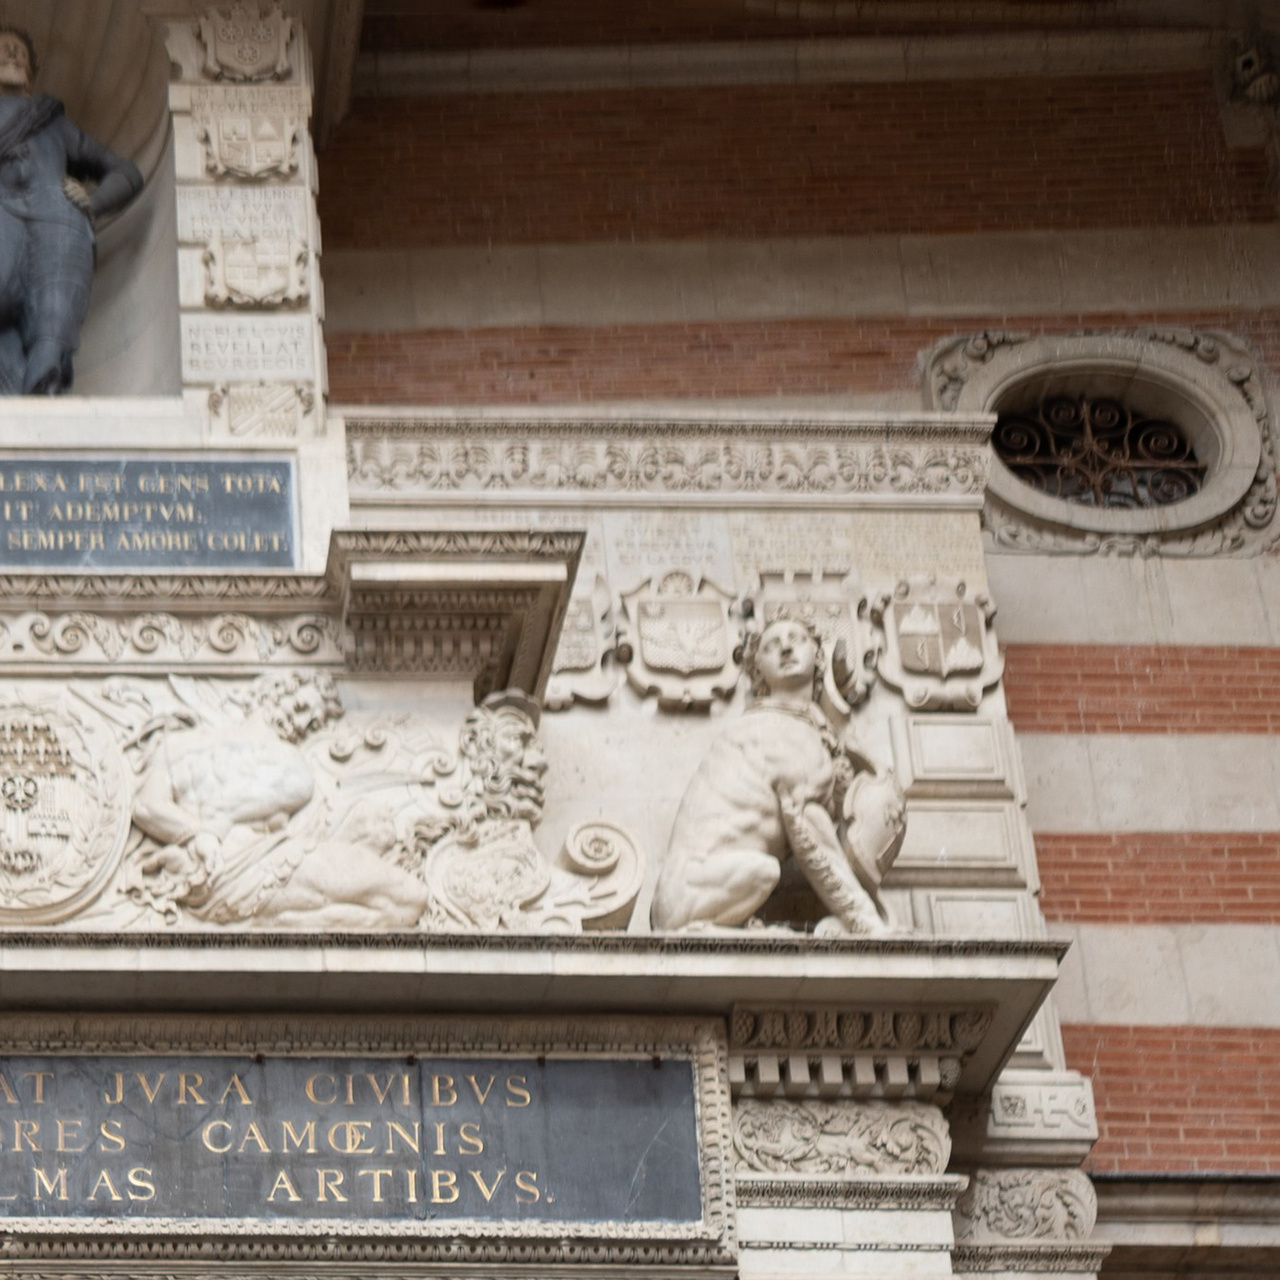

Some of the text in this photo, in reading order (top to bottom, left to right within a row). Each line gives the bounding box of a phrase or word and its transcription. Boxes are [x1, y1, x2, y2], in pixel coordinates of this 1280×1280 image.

[138, 472, 210, 493] GENS
[8, 529, 105, 550] SEMPER
[117, 531, 197, 551] AMORE
[104, 1071, 253, 1105] JVRA
[304, 1073, 532, 1108] CIVIBVS
[202, 1120, 485, 1156] CAMŒNIS
[266, 1168, 556, 1204] ARTIBVS.
